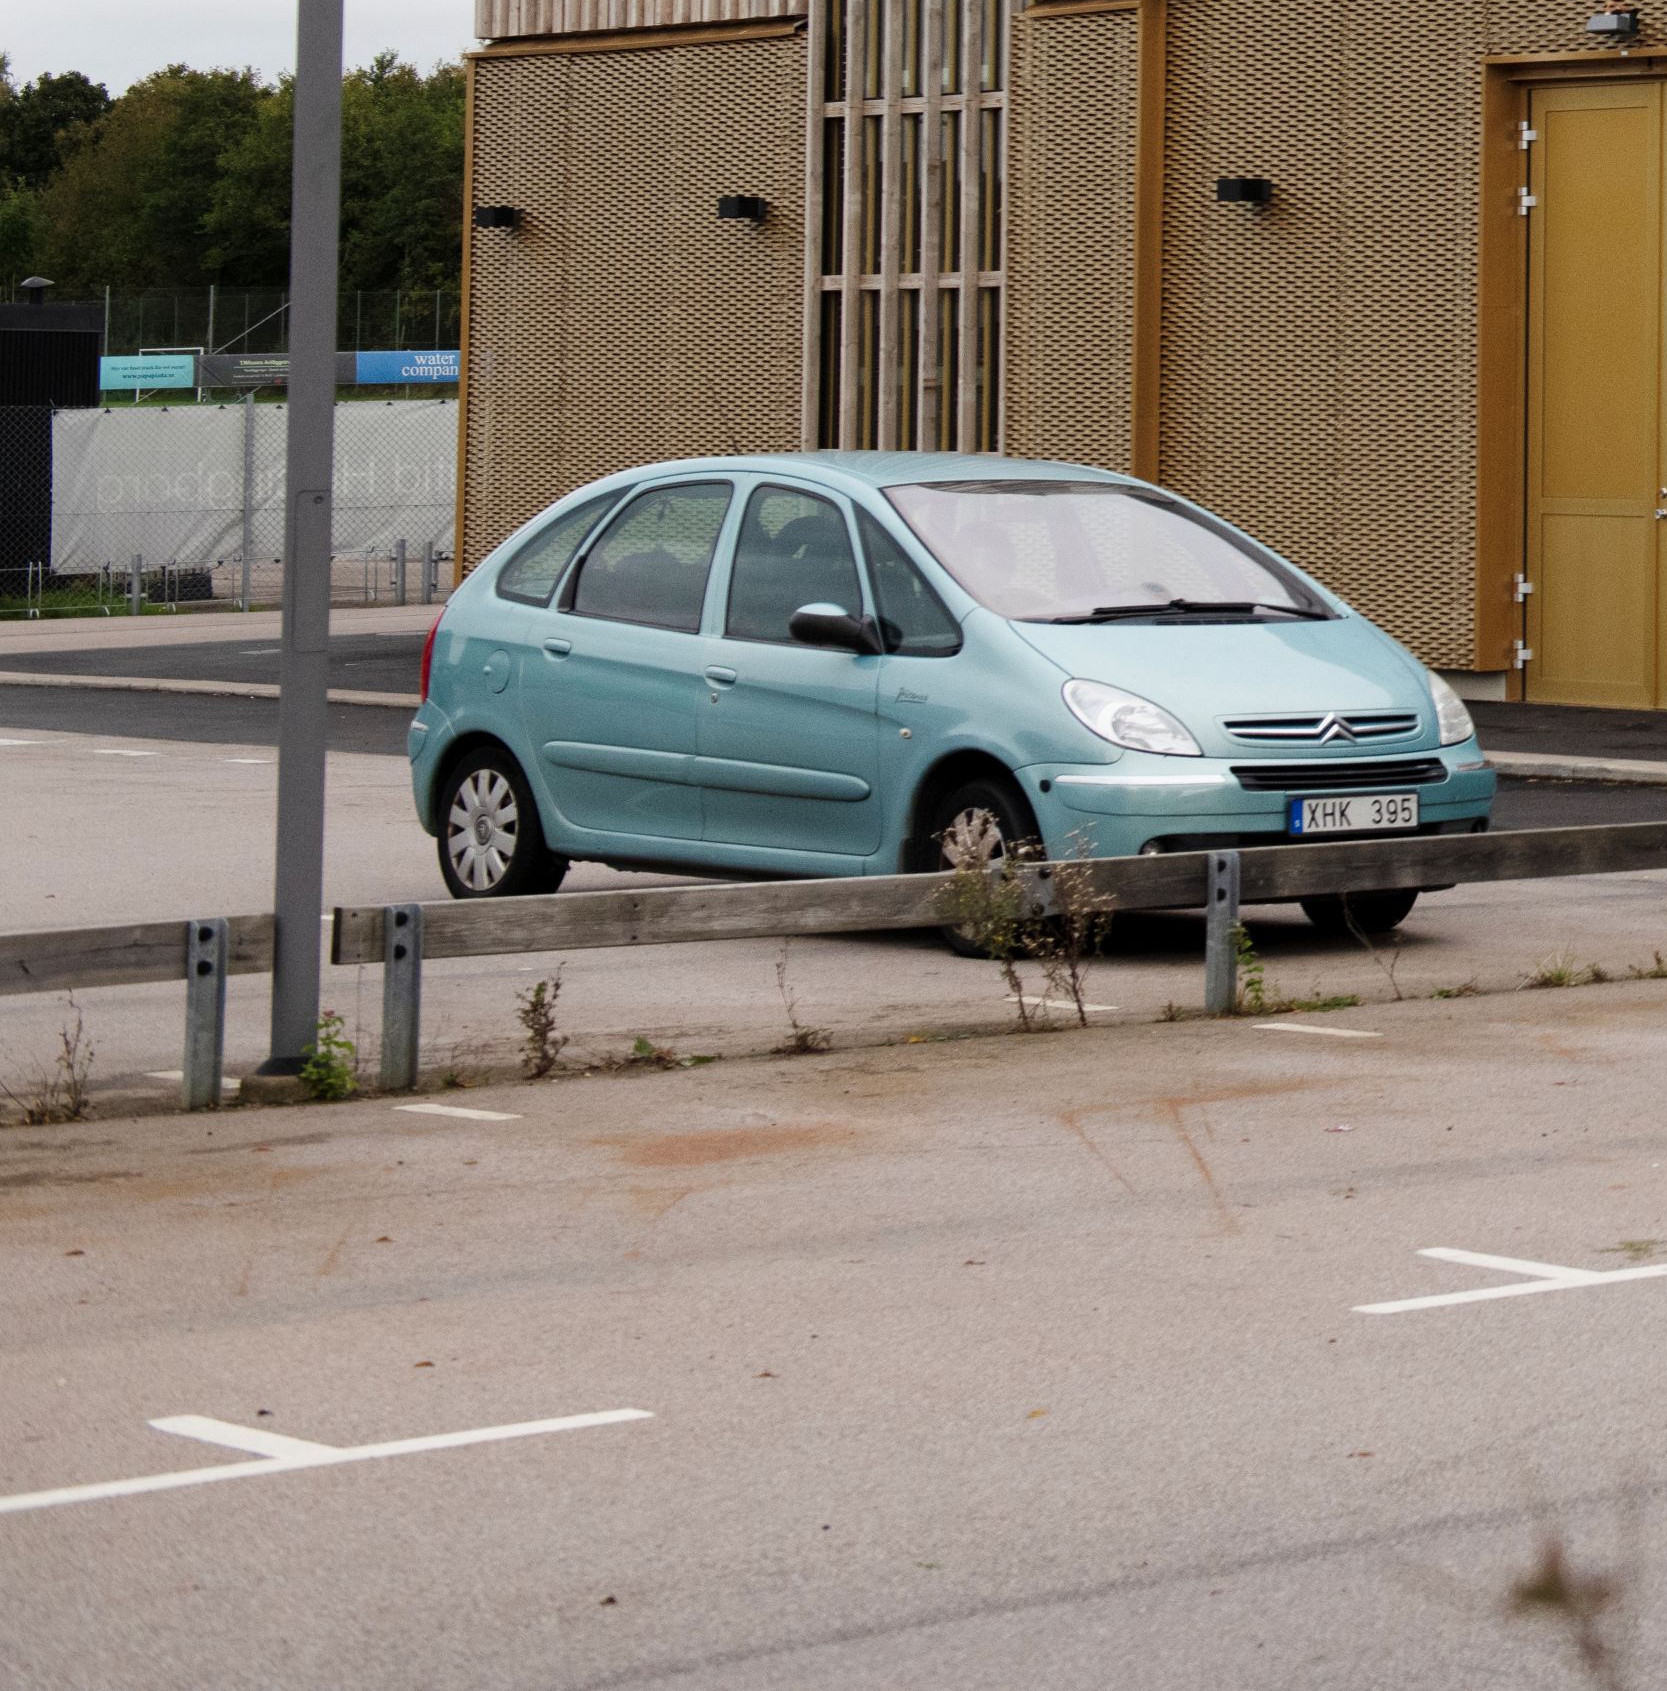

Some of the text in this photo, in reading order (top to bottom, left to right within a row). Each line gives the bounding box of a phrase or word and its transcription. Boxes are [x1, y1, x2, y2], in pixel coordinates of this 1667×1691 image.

[413, 353, 456, 365] water
[401, 365, 459, 380] compan
[1307, 797, 1413, 829] XHK 395
